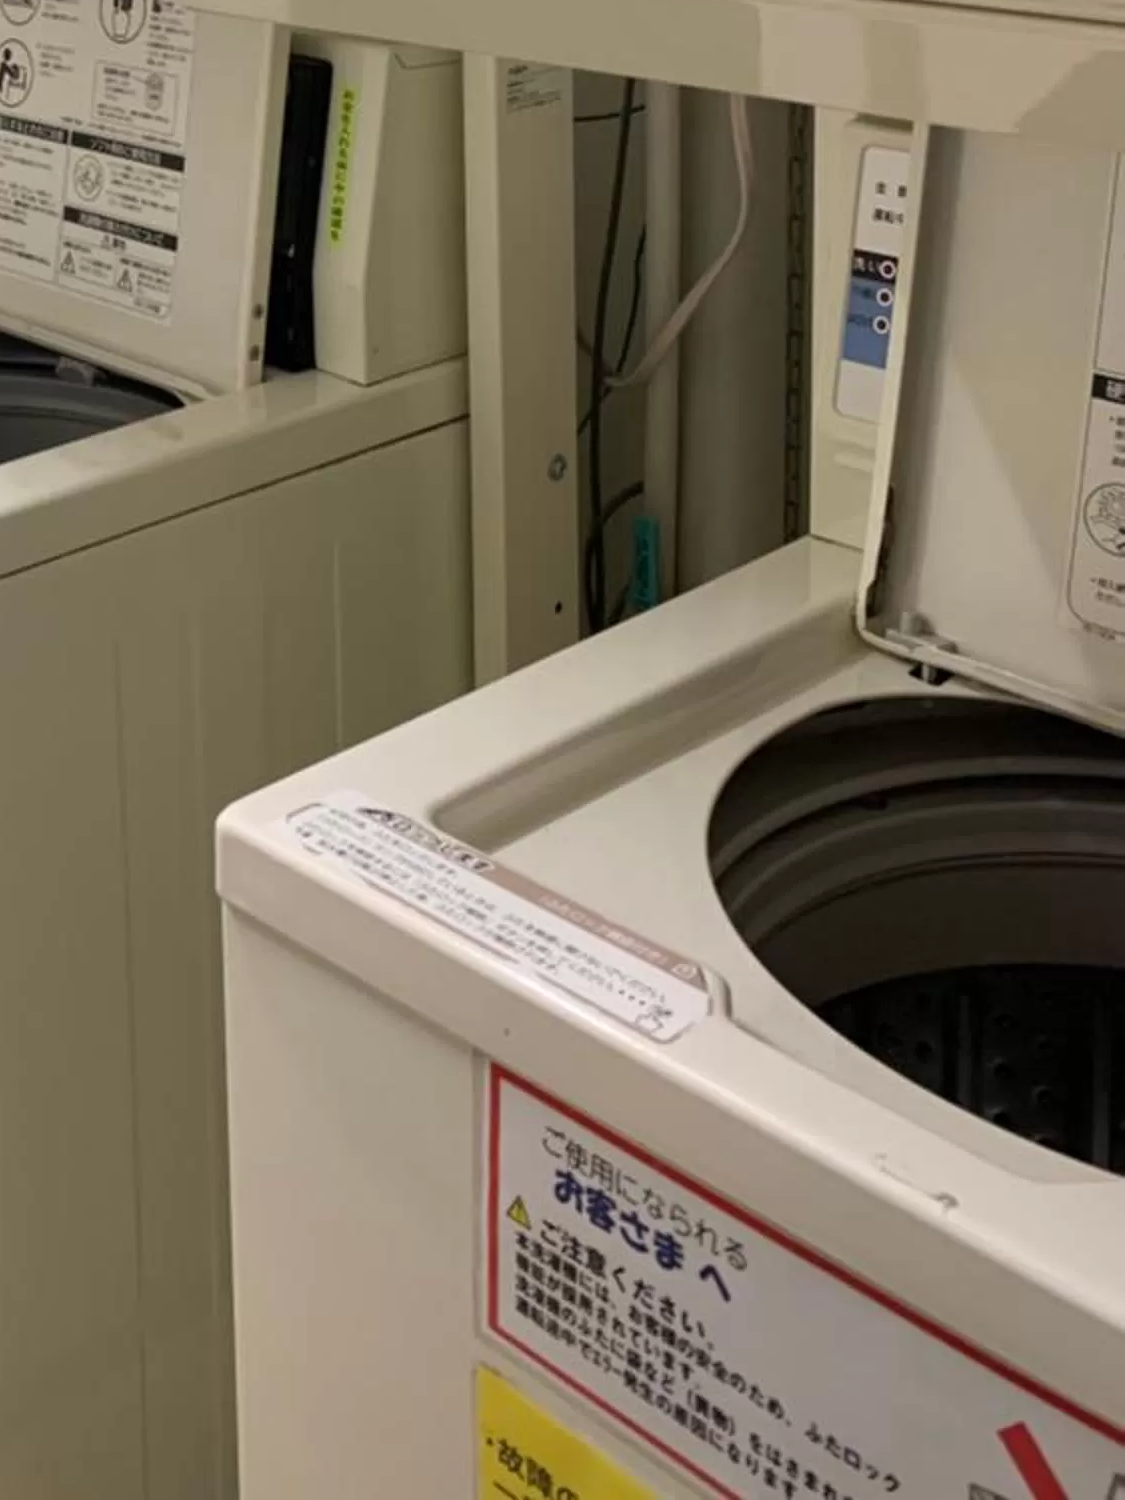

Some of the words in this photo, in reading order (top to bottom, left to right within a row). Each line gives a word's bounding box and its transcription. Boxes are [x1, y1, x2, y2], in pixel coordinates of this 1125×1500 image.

[541, 1125, 748, 1272] ご使用になられる
[553, 1168, 732, 1302] お客さまへ
